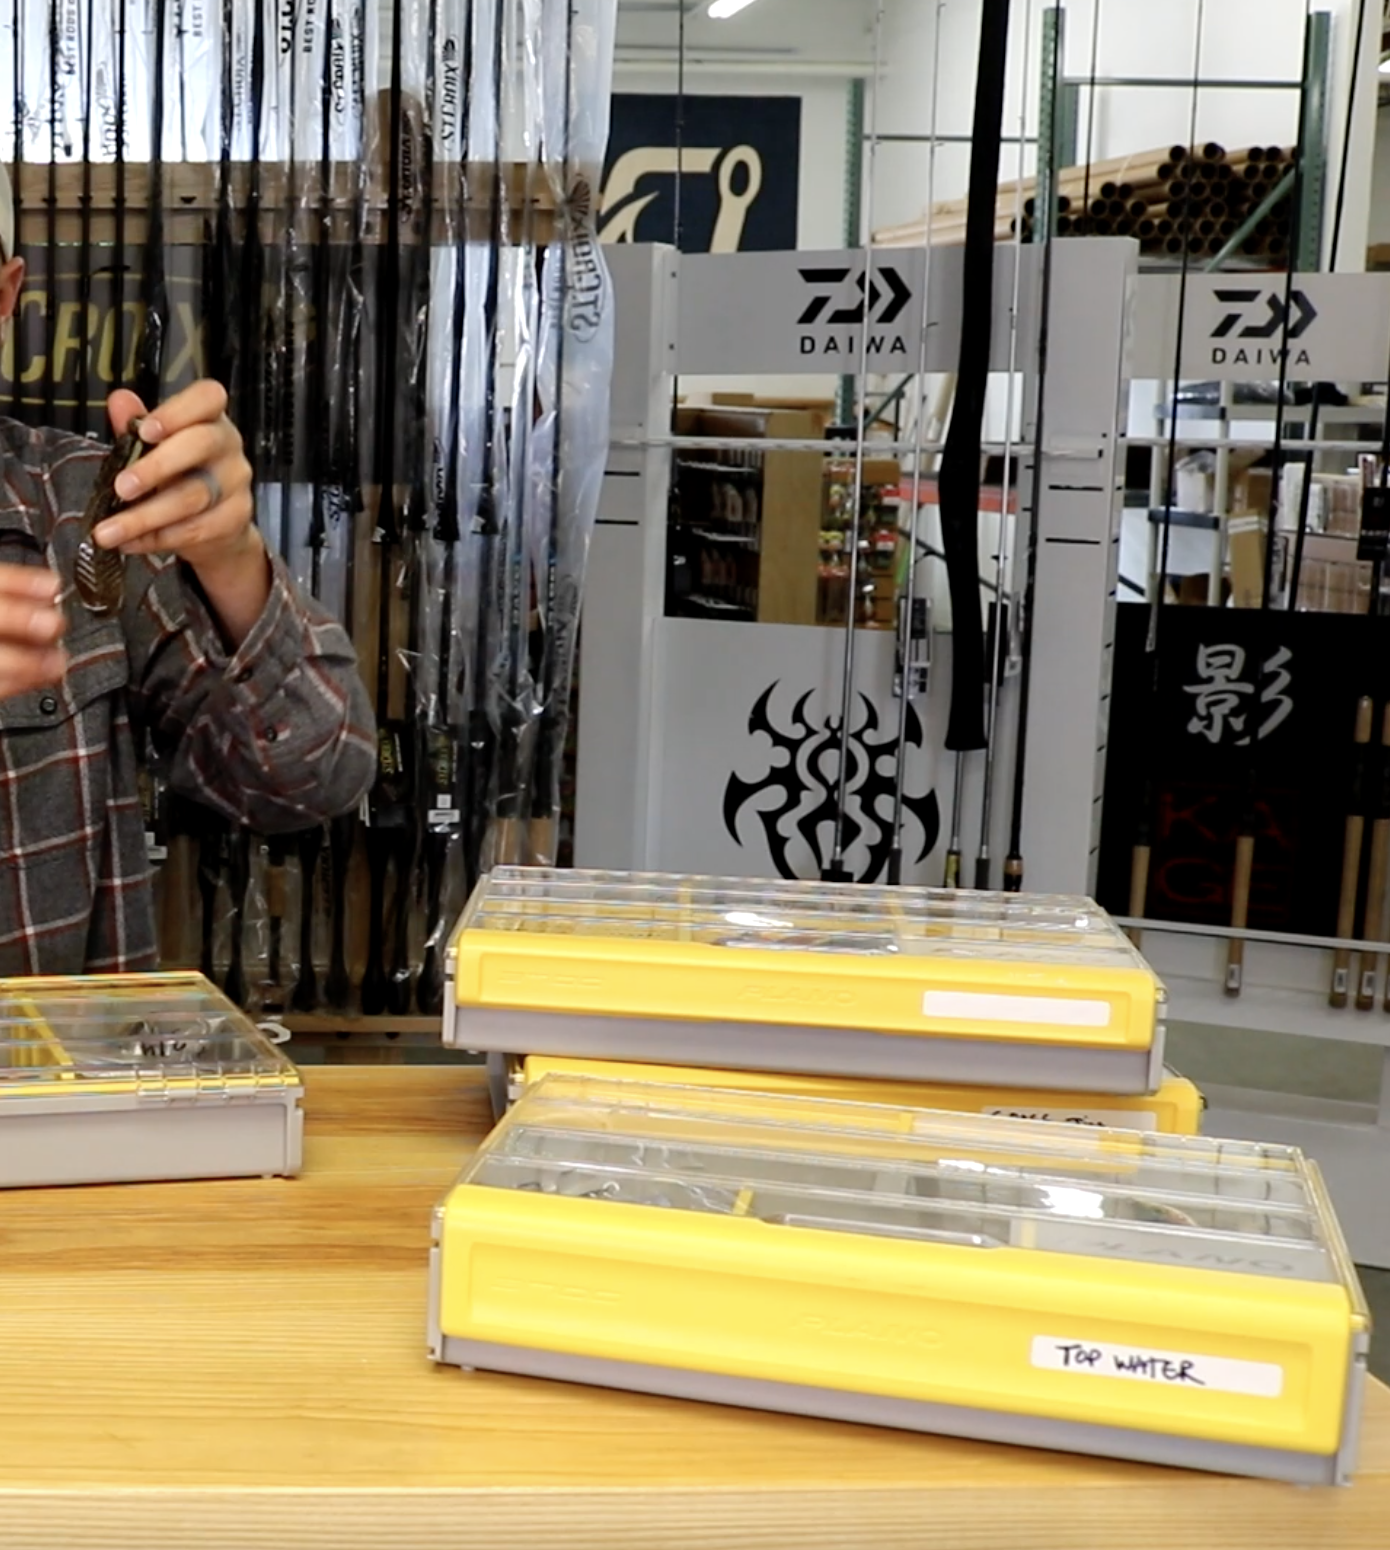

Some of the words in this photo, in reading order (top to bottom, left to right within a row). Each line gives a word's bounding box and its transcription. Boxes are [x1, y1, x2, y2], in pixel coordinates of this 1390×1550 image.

[0, 289, 207, 384] CROX
[800, 335, 907, 354] DAIWA
[1212, 347, 1311, 366] DAIWA
[1182, 643, 1294, 746] 影
[1055, 1344, 1101, 1367] TOP
